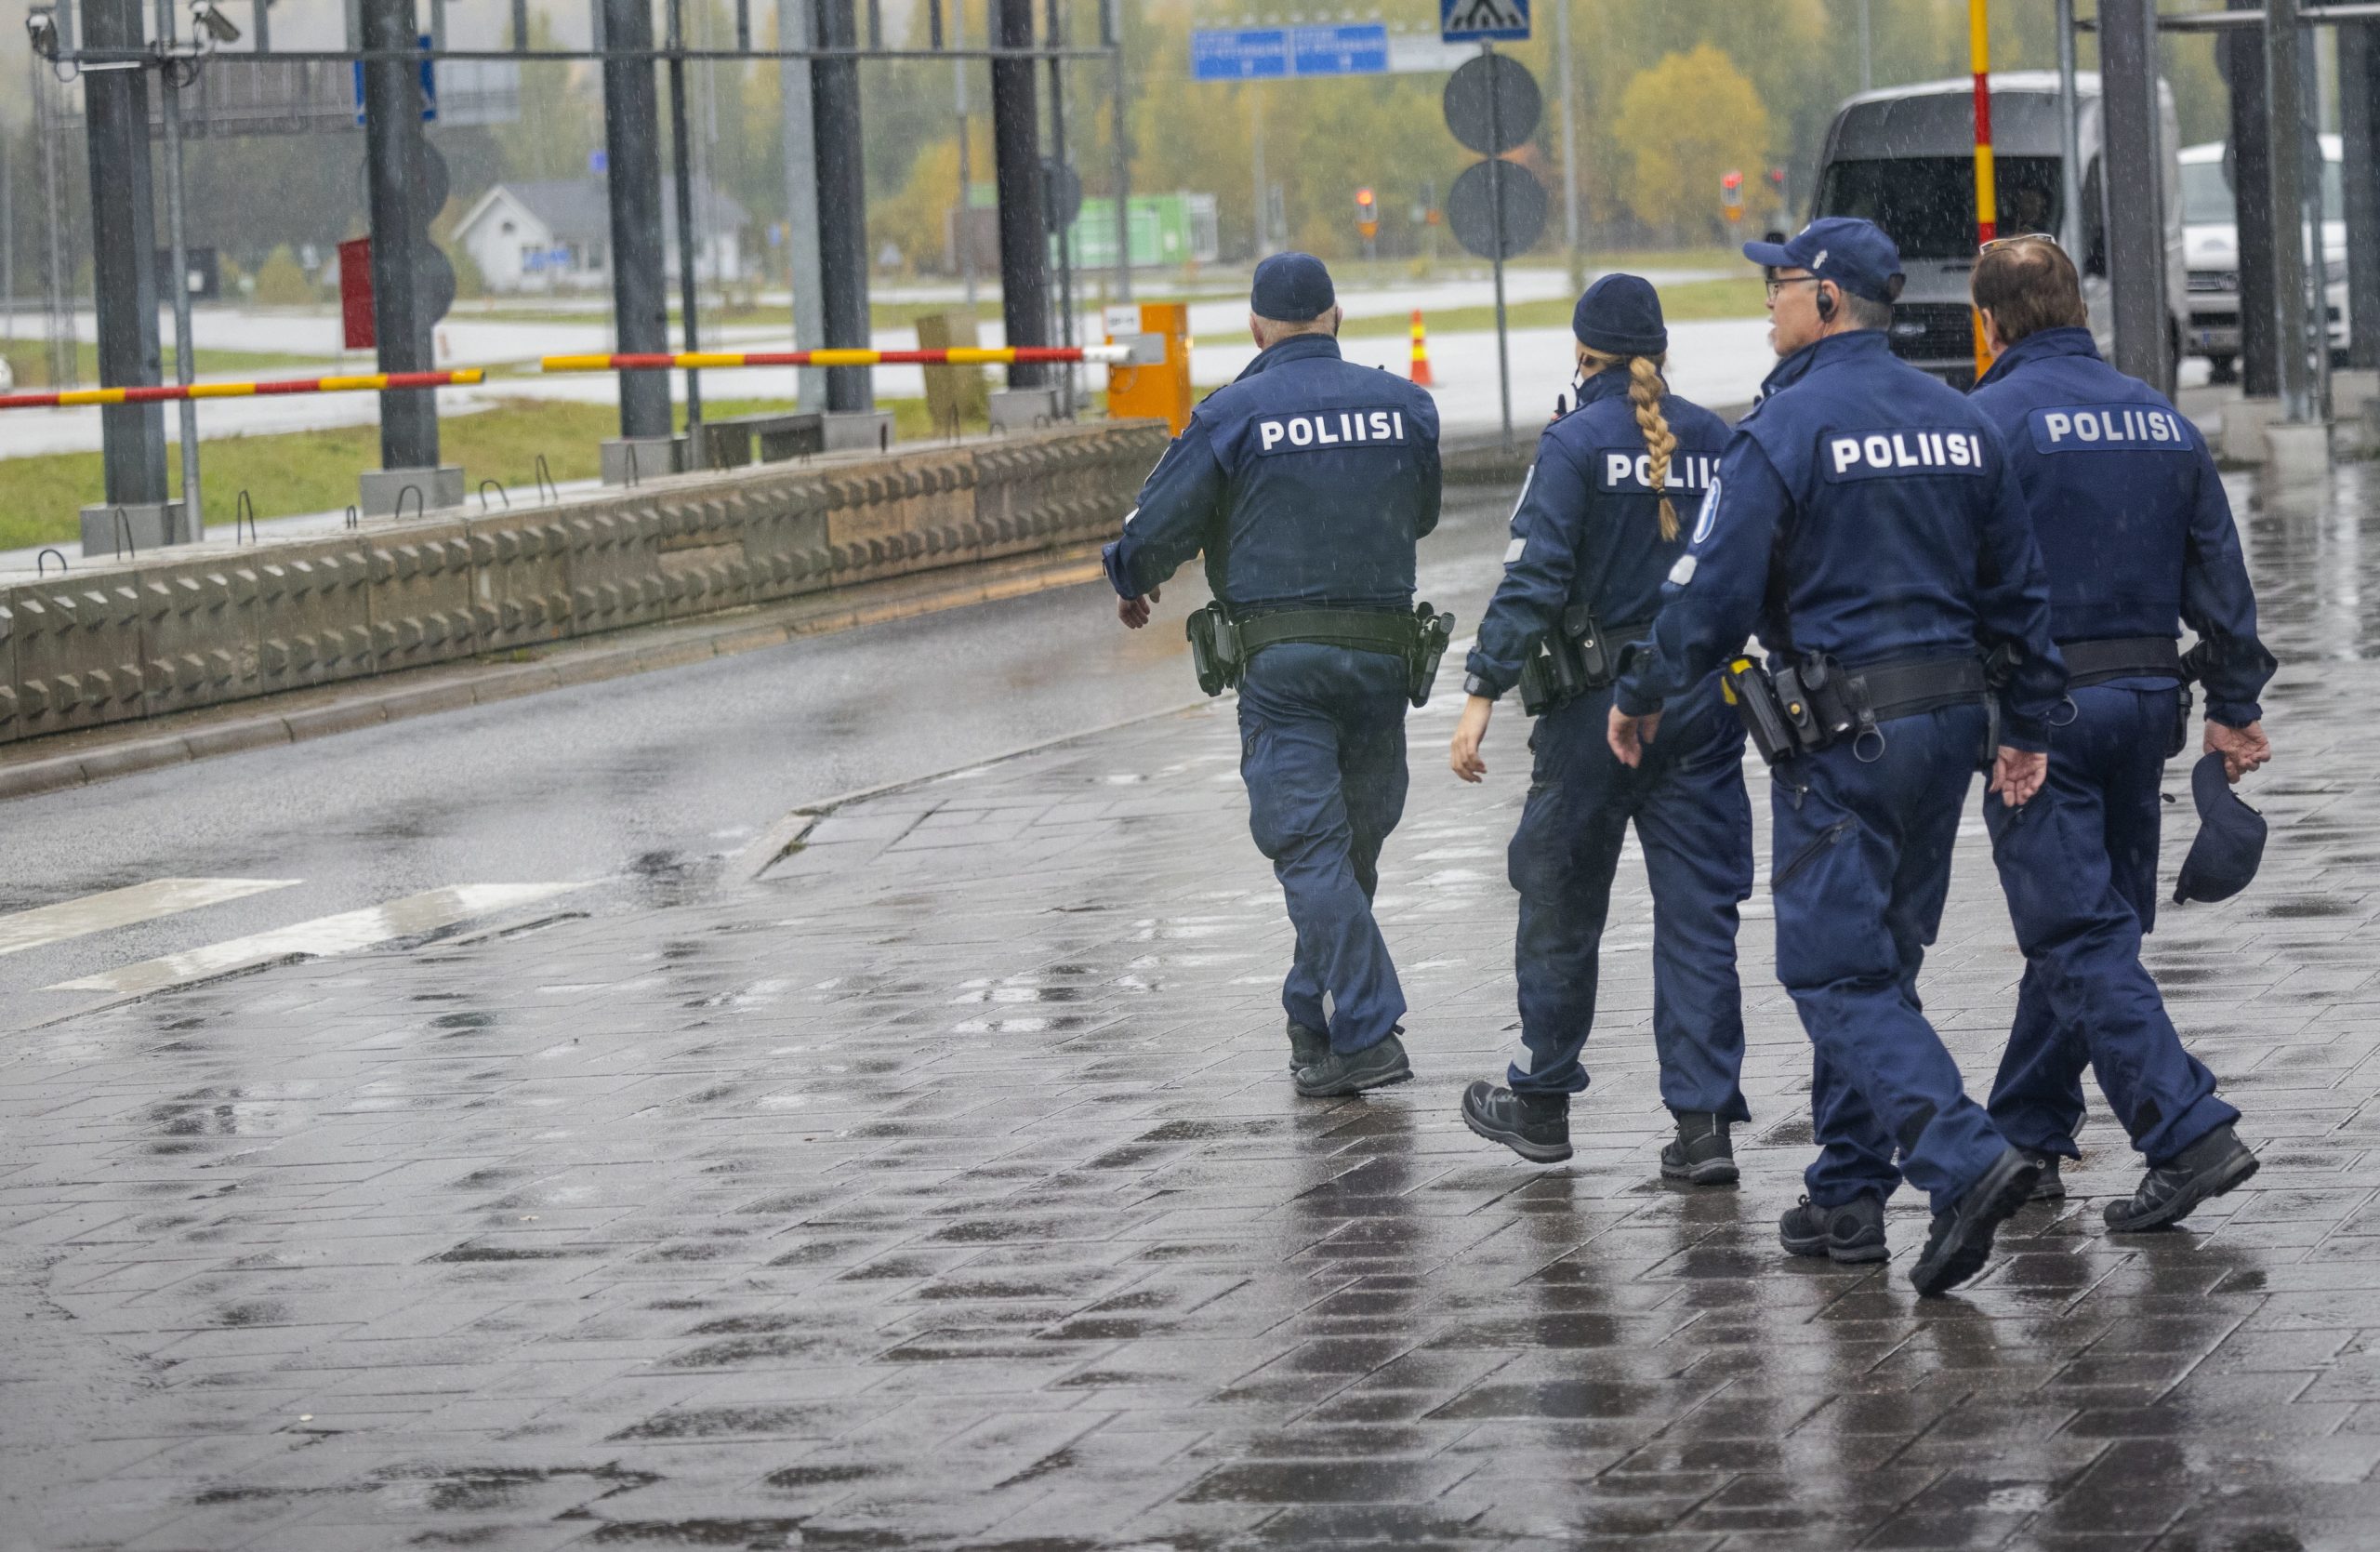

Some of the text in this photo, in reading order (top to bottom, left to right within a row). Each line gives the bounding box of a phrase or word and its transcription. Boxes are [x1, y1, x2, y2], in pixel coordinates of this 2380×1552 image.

[1260, 411, 1404, 451] POLIISI
[2044, 410, 2181, 443] POLIISI
[1831, 431, 1982, 473] POLIISI
[1606, 454, 1721, 489] POLII
